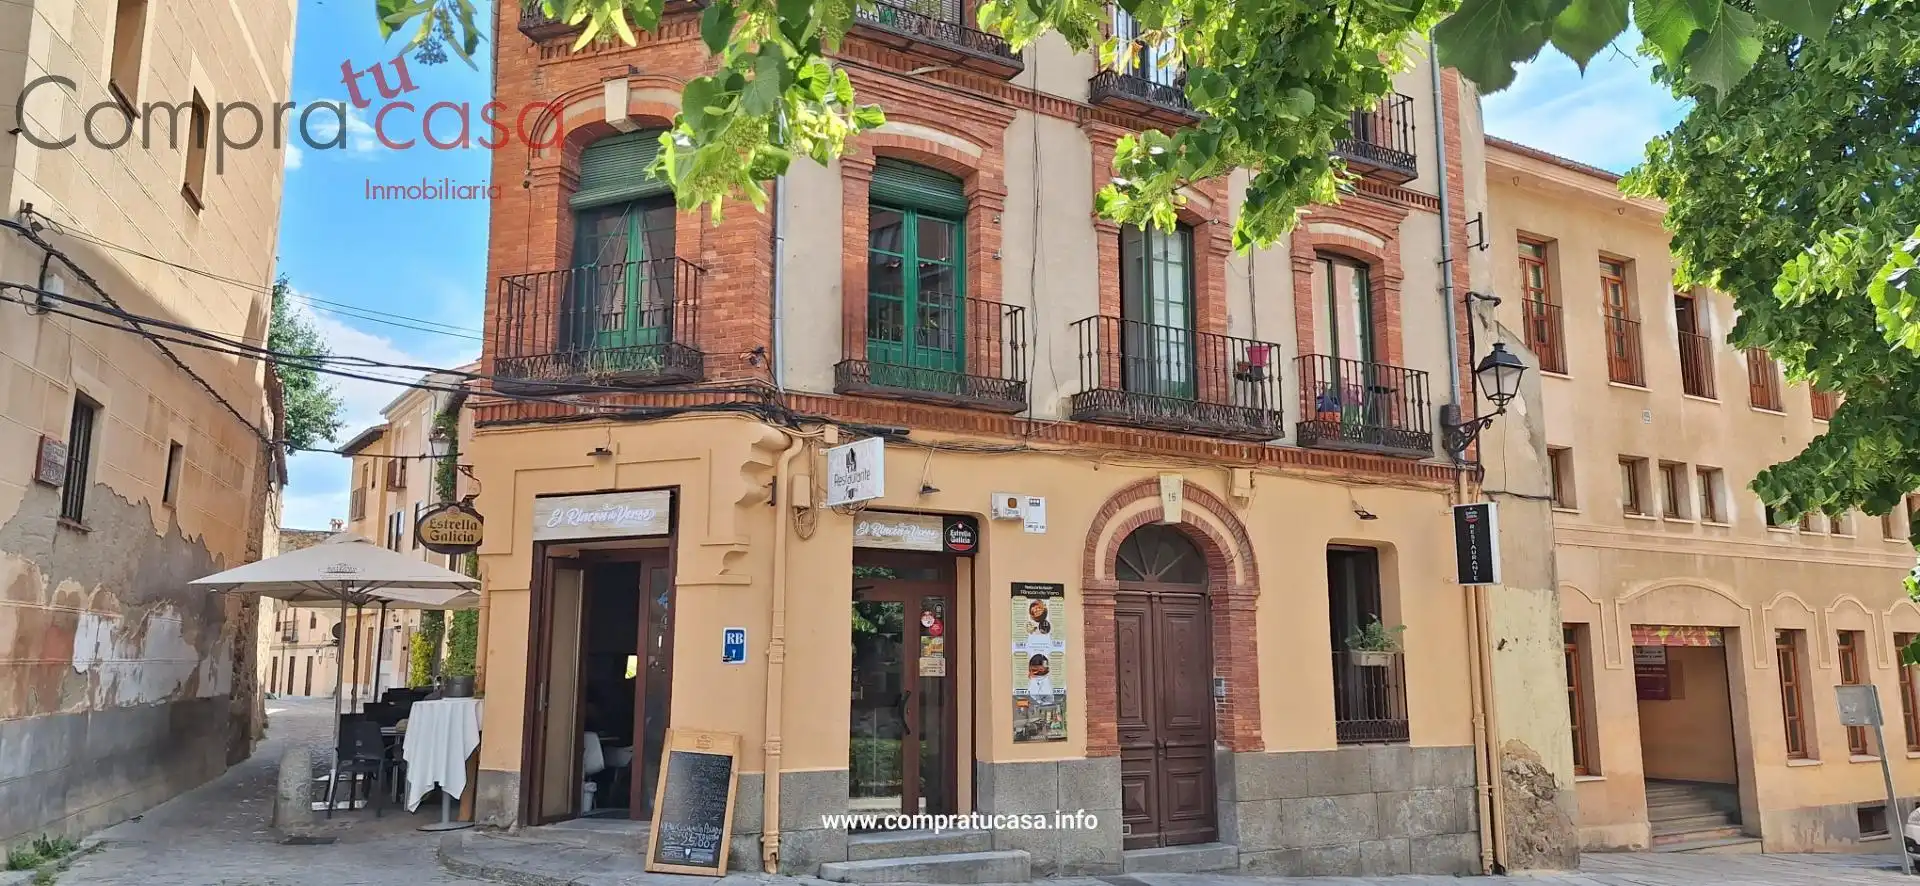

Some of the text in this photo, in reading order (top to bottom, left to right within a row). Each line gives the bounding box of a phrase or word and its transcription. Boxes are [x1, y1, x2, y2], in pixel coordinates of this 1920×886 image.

[834, 468, 871, 487] Restaurante
[428, 518, 478, 530] Estrella
[546, 508, 563, 529] El
[855, 520, 868, 536] El
[950, 529, 972, 538] Estrella
[430, 530, 474, 542] Galicia
[1469, 524, 1478, 581] RESTAURANTE
[727, 632, 744, 645] RB
